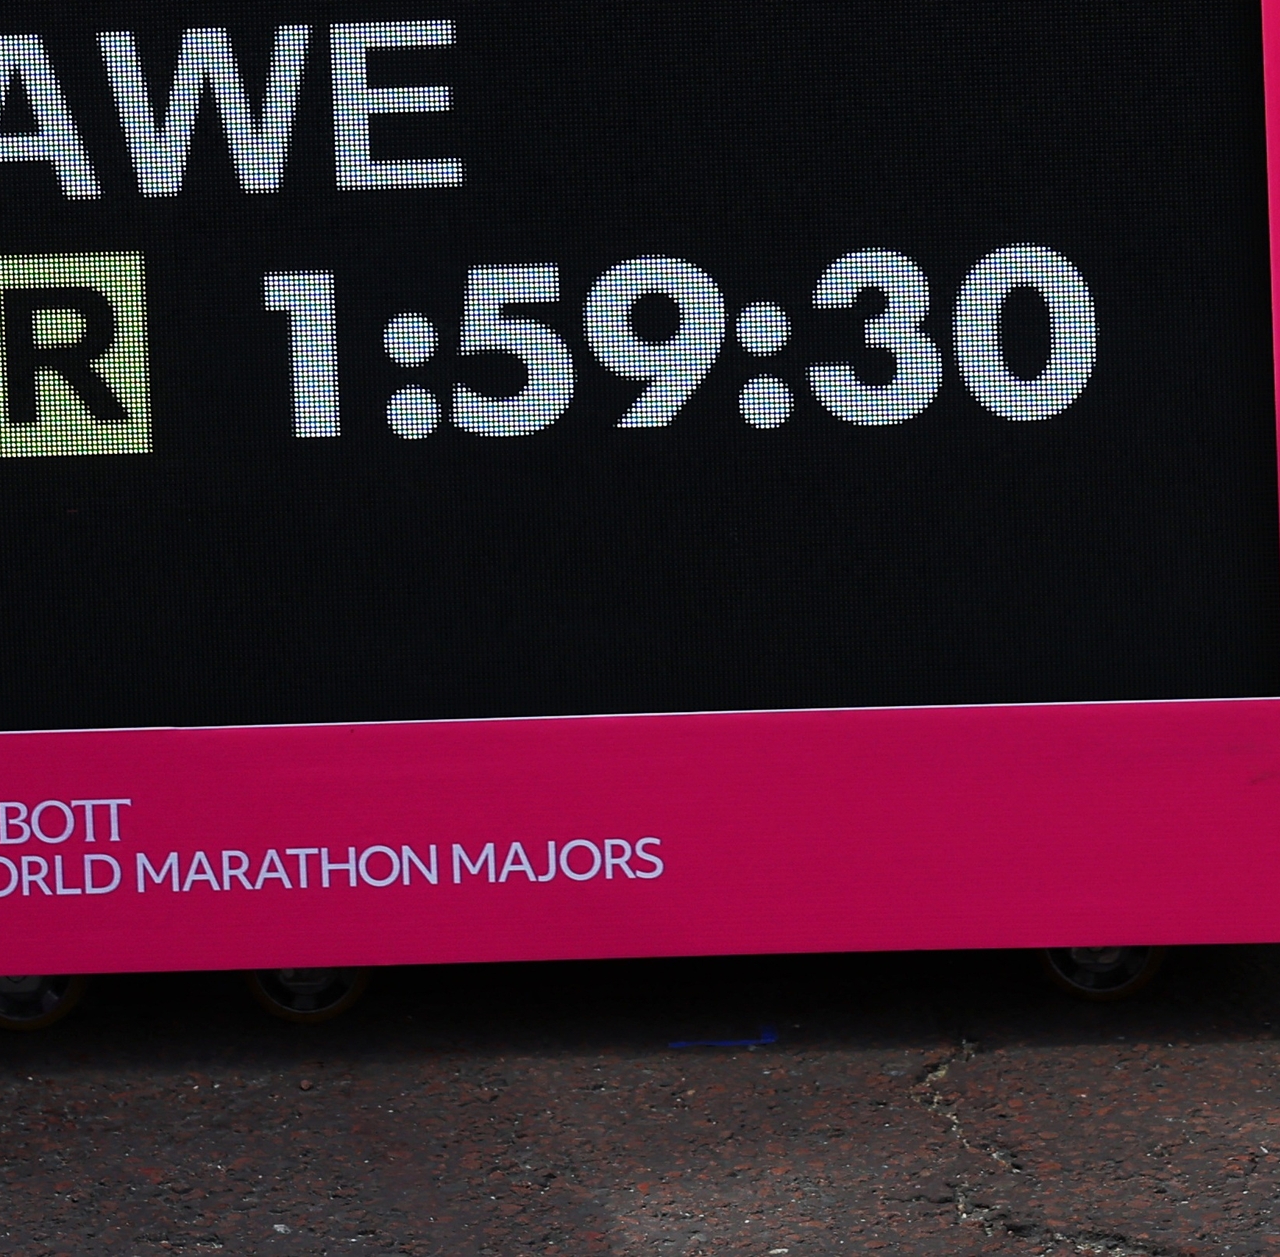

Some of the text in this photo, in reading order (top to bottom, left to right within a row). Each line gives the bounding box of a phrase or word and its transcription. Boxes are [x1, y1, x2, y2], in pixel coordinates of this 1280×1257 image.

[261, 242, 1099, 439] 1:59:30
[137, 844, 440, 893] MARATHON
[450, 837, 665, 883] MAJORS
